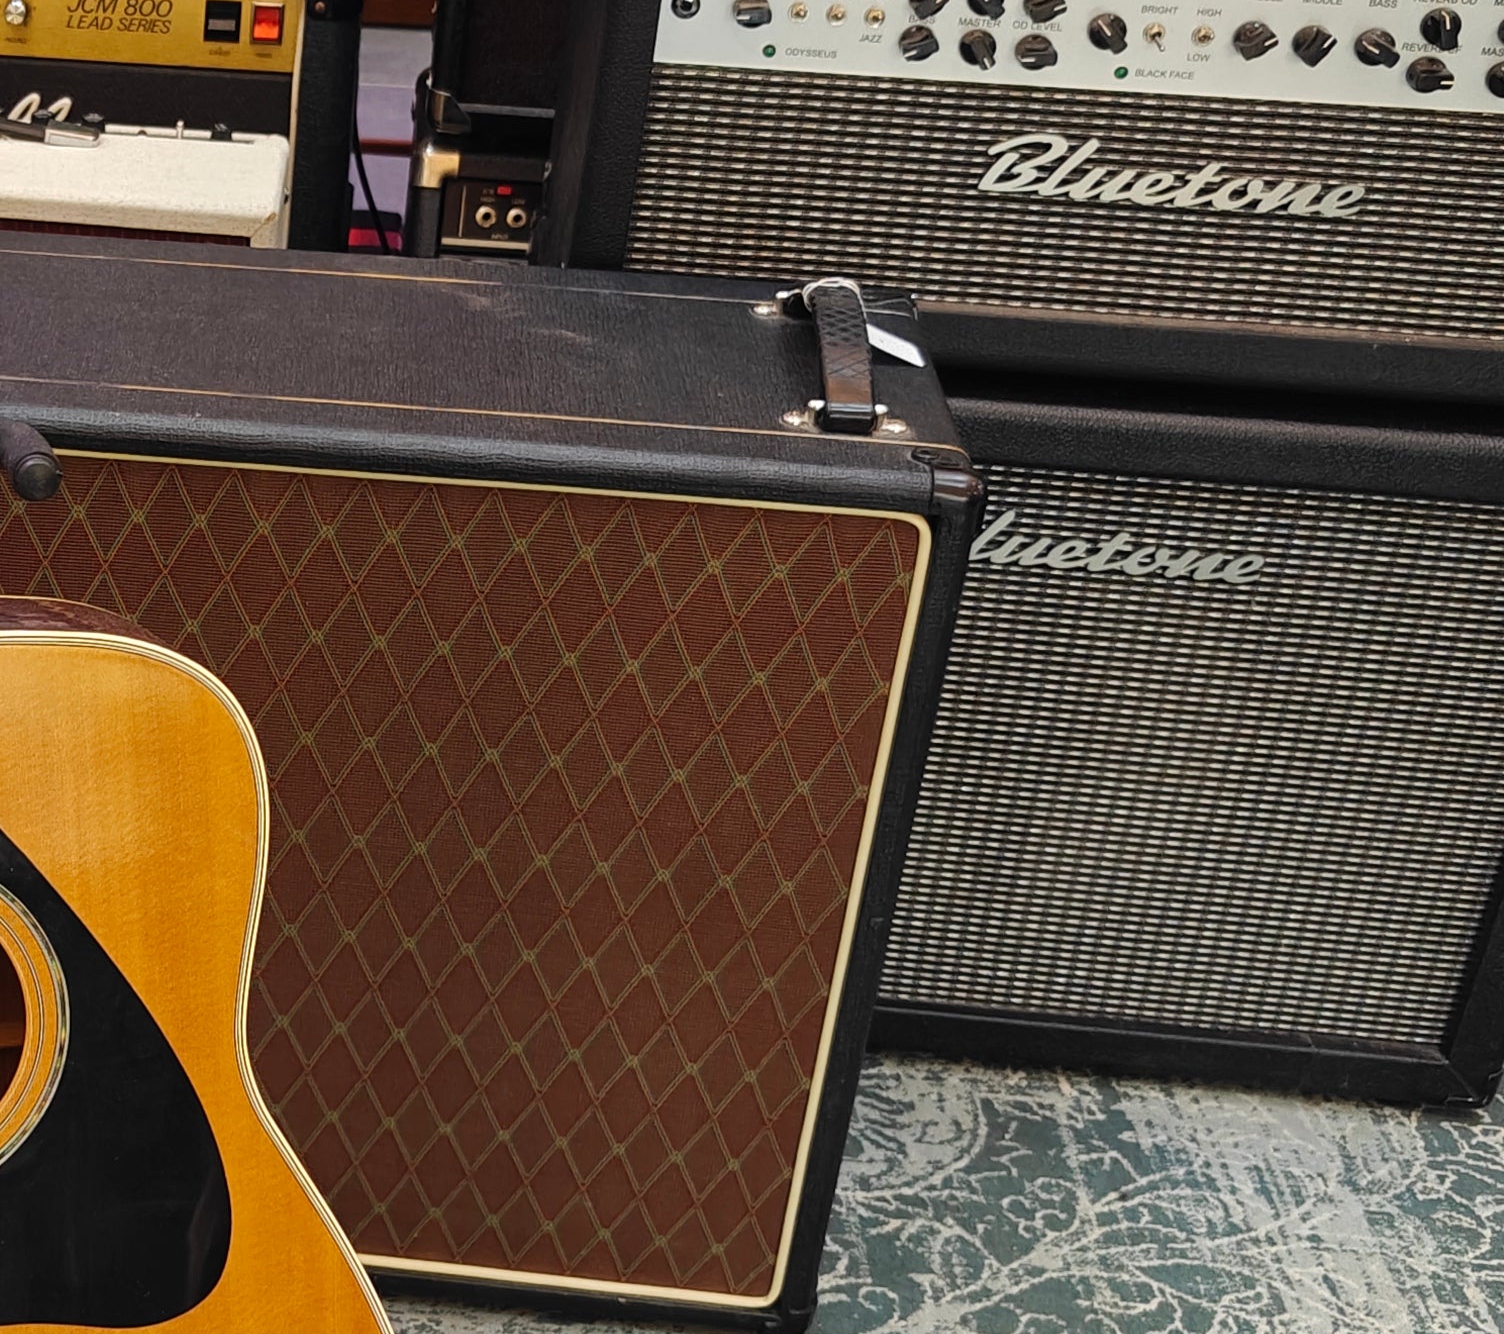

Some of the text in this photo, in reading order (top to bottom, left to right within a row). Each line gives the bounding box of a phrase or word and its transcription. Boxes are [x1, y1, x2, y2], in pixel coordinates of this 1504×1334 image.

[1141, 5, 1179, 15] BRIGHT
[1197, 8, 1223, 18] HIGH
[66, 14, 172, 35] LEAD SERIES
[958, 17, 1001, 28] MASTER
[1012, 20, 1063, 32] OD LEVEL
[859, 34, 883, 44] JAZZ
[785, 47, 837, 59] ODYSSEUS
[1186, 53, 1211, 63] LOW
[1134, 68, 1195, 81] BLACK FACE
[978, 133, 1366, 219] Bluetone
[969, 510, 1265, 584] luetone
